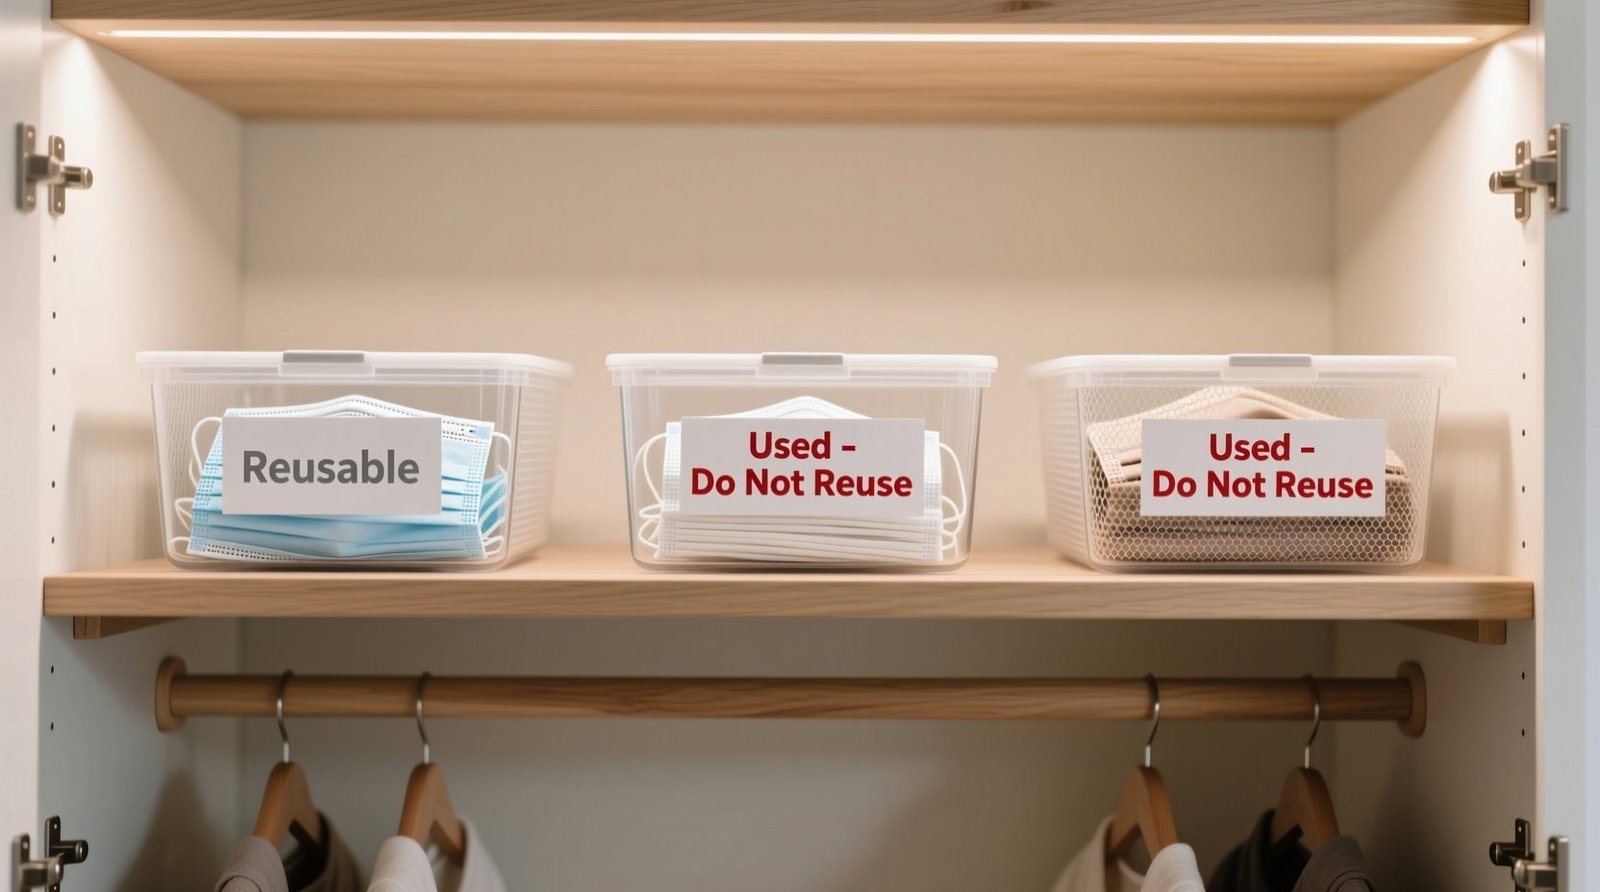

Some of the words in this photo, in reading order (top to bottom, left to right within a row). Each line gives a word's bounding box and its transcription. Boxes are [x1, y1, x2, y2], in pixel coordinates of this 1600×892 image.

[749, 431, 831, 460] Used
[1209, 433, 1291, 461] Used
[243, 449, 420, 484] Reusable
[691, 466, 736, 497] Do
[745, 468, 805, 497] Not
[813, 467, 913, 497] Reuse
[1152, 468, 1198, 498] Do
[1206, 470, 1267, 499] Not
[1274, 469, 1374, 499] Reuse
